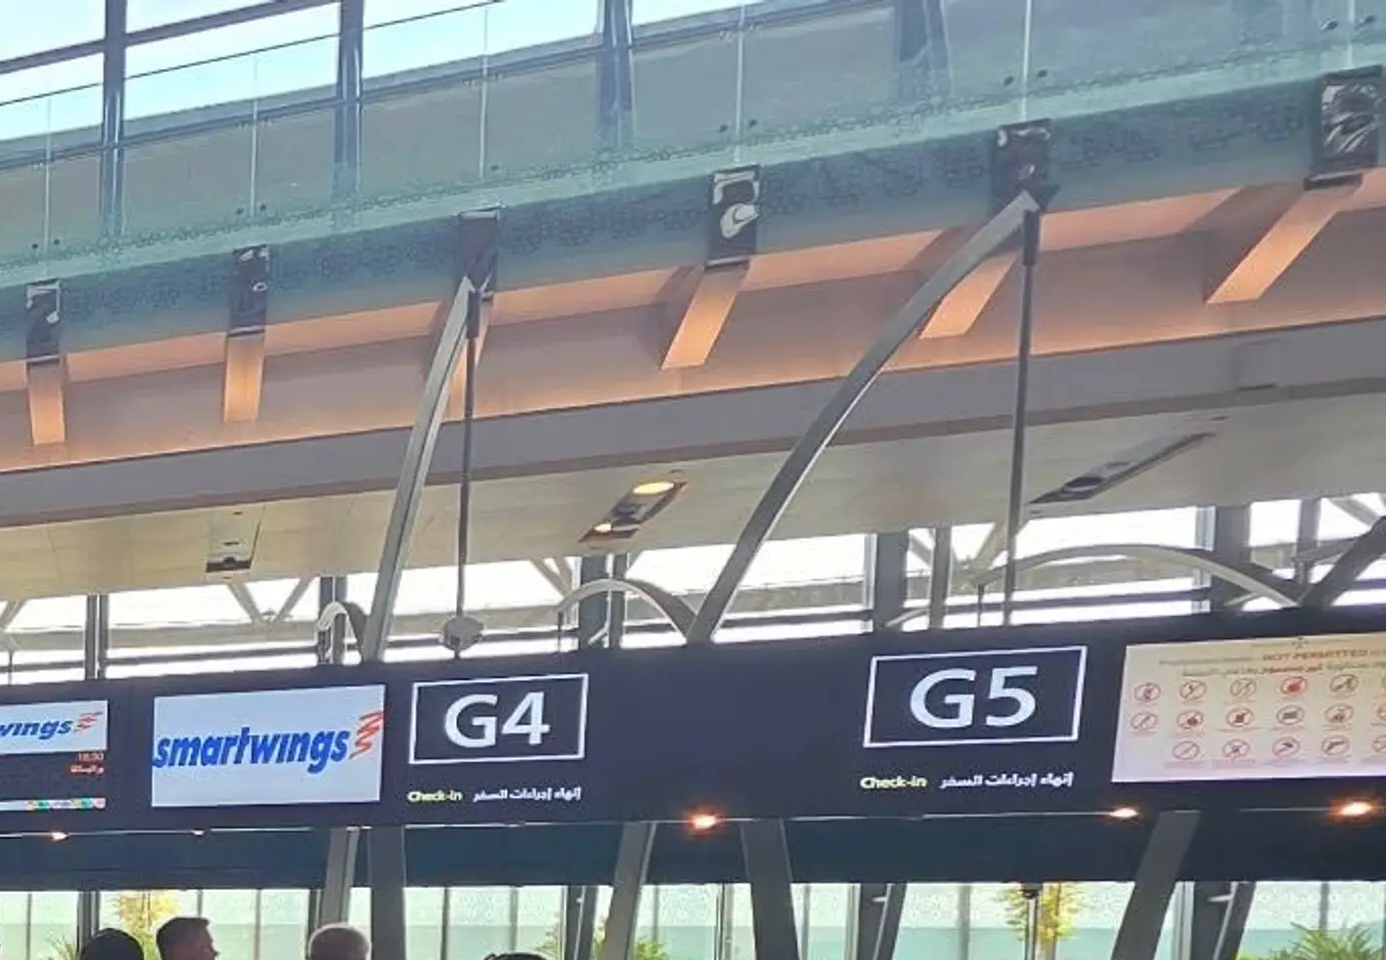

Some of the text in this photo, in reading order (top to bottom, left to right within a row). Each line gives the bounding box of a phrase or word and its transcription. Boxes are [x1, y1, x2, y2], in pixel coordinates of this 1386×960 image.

[443, 692, 550, 747] G4
[909, 666, 1038, 730] G5
[152, 727, 350, 774] smartwings
[859, 775, 928, 789] Check-in
